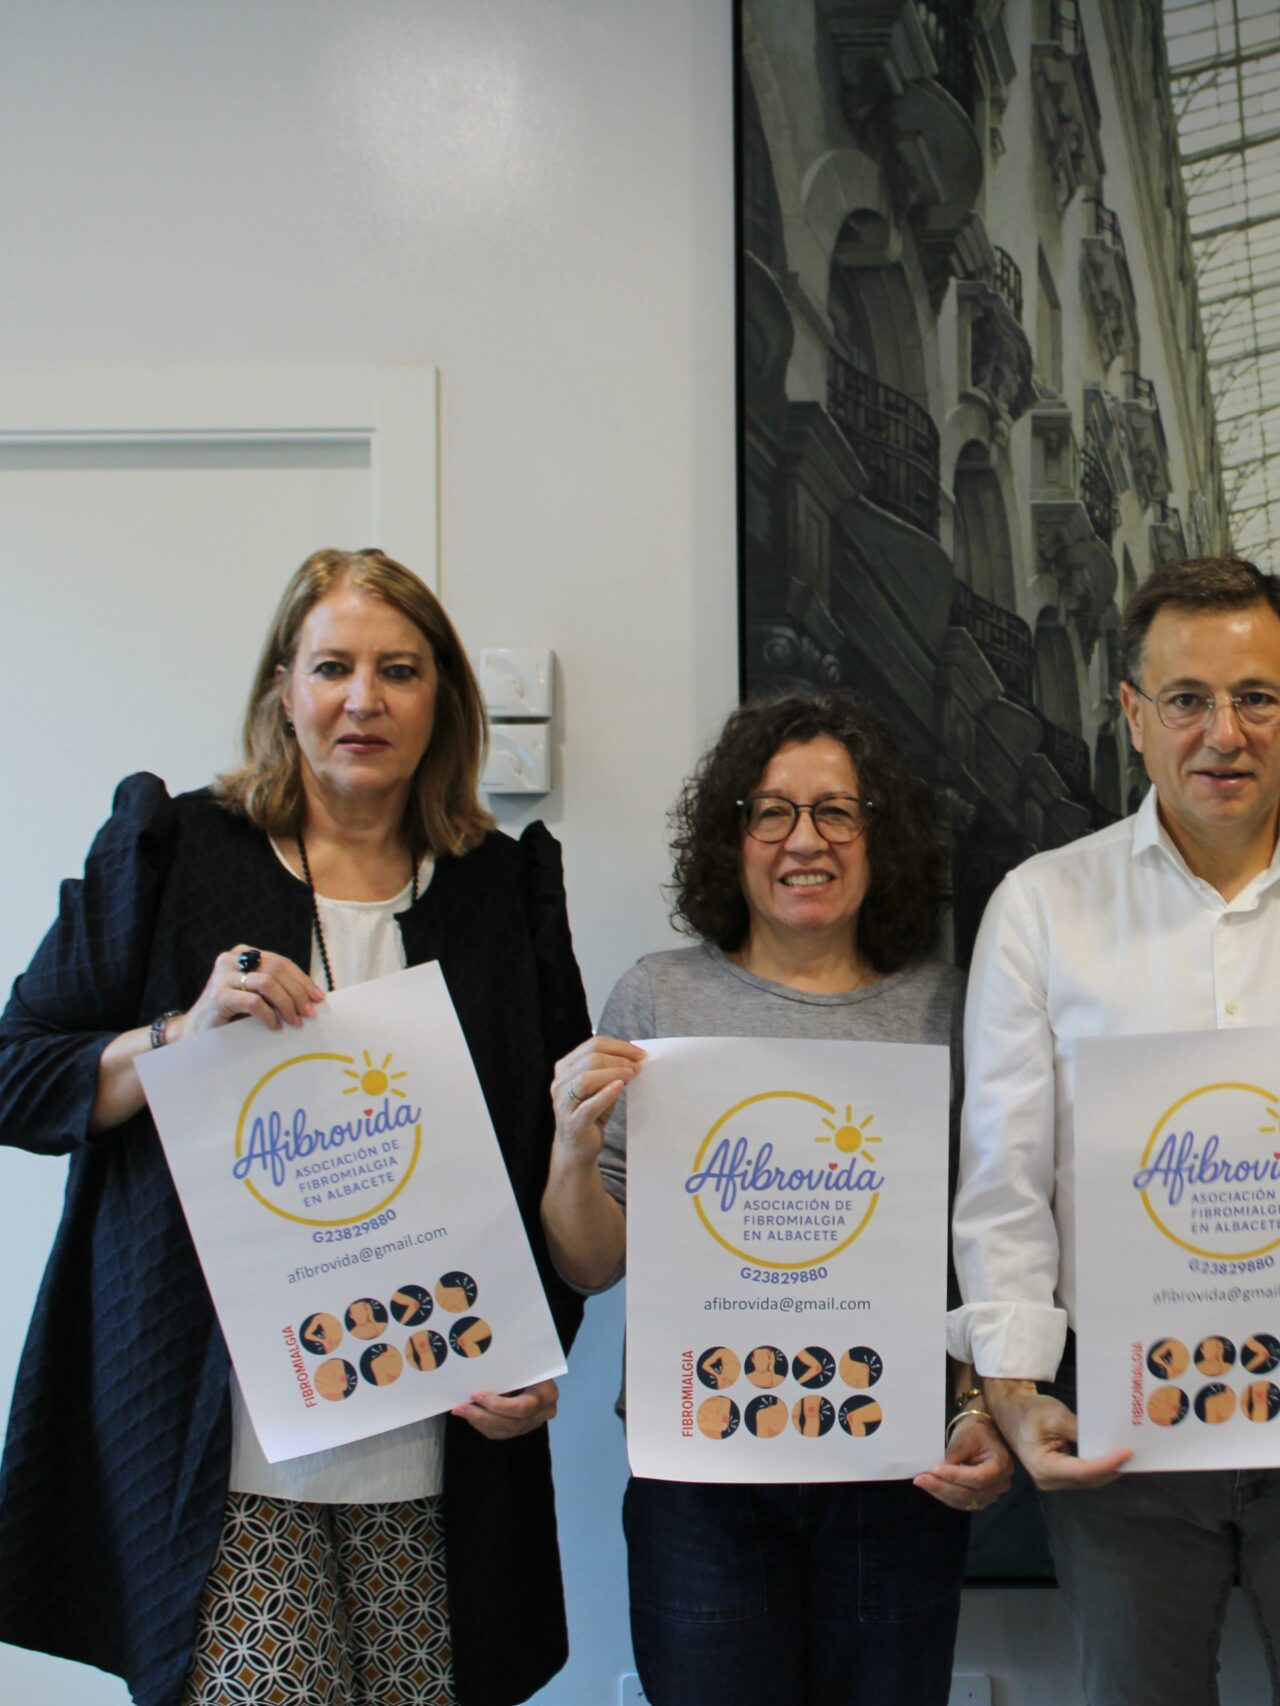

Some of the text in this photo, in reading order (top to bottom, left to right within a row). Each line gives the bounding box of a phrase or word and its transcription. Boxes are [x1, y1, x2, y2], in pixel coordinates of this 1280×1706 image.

[233, 1098, 421, 1187] Afibrovida
[295, 1140, 400, 1179] ASOCIACIÓN DE
[299, 1156, 398, 1193] FIBROMIALGIA
[303, 1172, 395, 1207] EN ALBACETE
[685, 1137, 885, 1212] Afibrovida
[744, 1198, 853, 1211] ASOCIACIÓN DE
[1191, 1188, 1276, 1204] ASOCIACIÓN
[312, 1209, 397, 1244] G23829880
[744, 1215, 846, 1226] FIBROMIALGIA
[744, 1231, 838, 1241] EN ALBACETE
[1192, 1223, 1209, 1234] EN
[288, 1226, 447, 1284] afibrovida@gmail.com
[1188, 1255, 1275, 1275] G23829880
[740, 1267, 828, 1284] G23829880
[704, 1297, 871, 1313] afibrovida@gmail.com
[282, 1325, 317, 1408] FIBROMIALGIA
[1131, 1342, 1144, 1426] FIBROMIALGIA
[682, 1350, 694, 1437] FIBROMIALGIA
